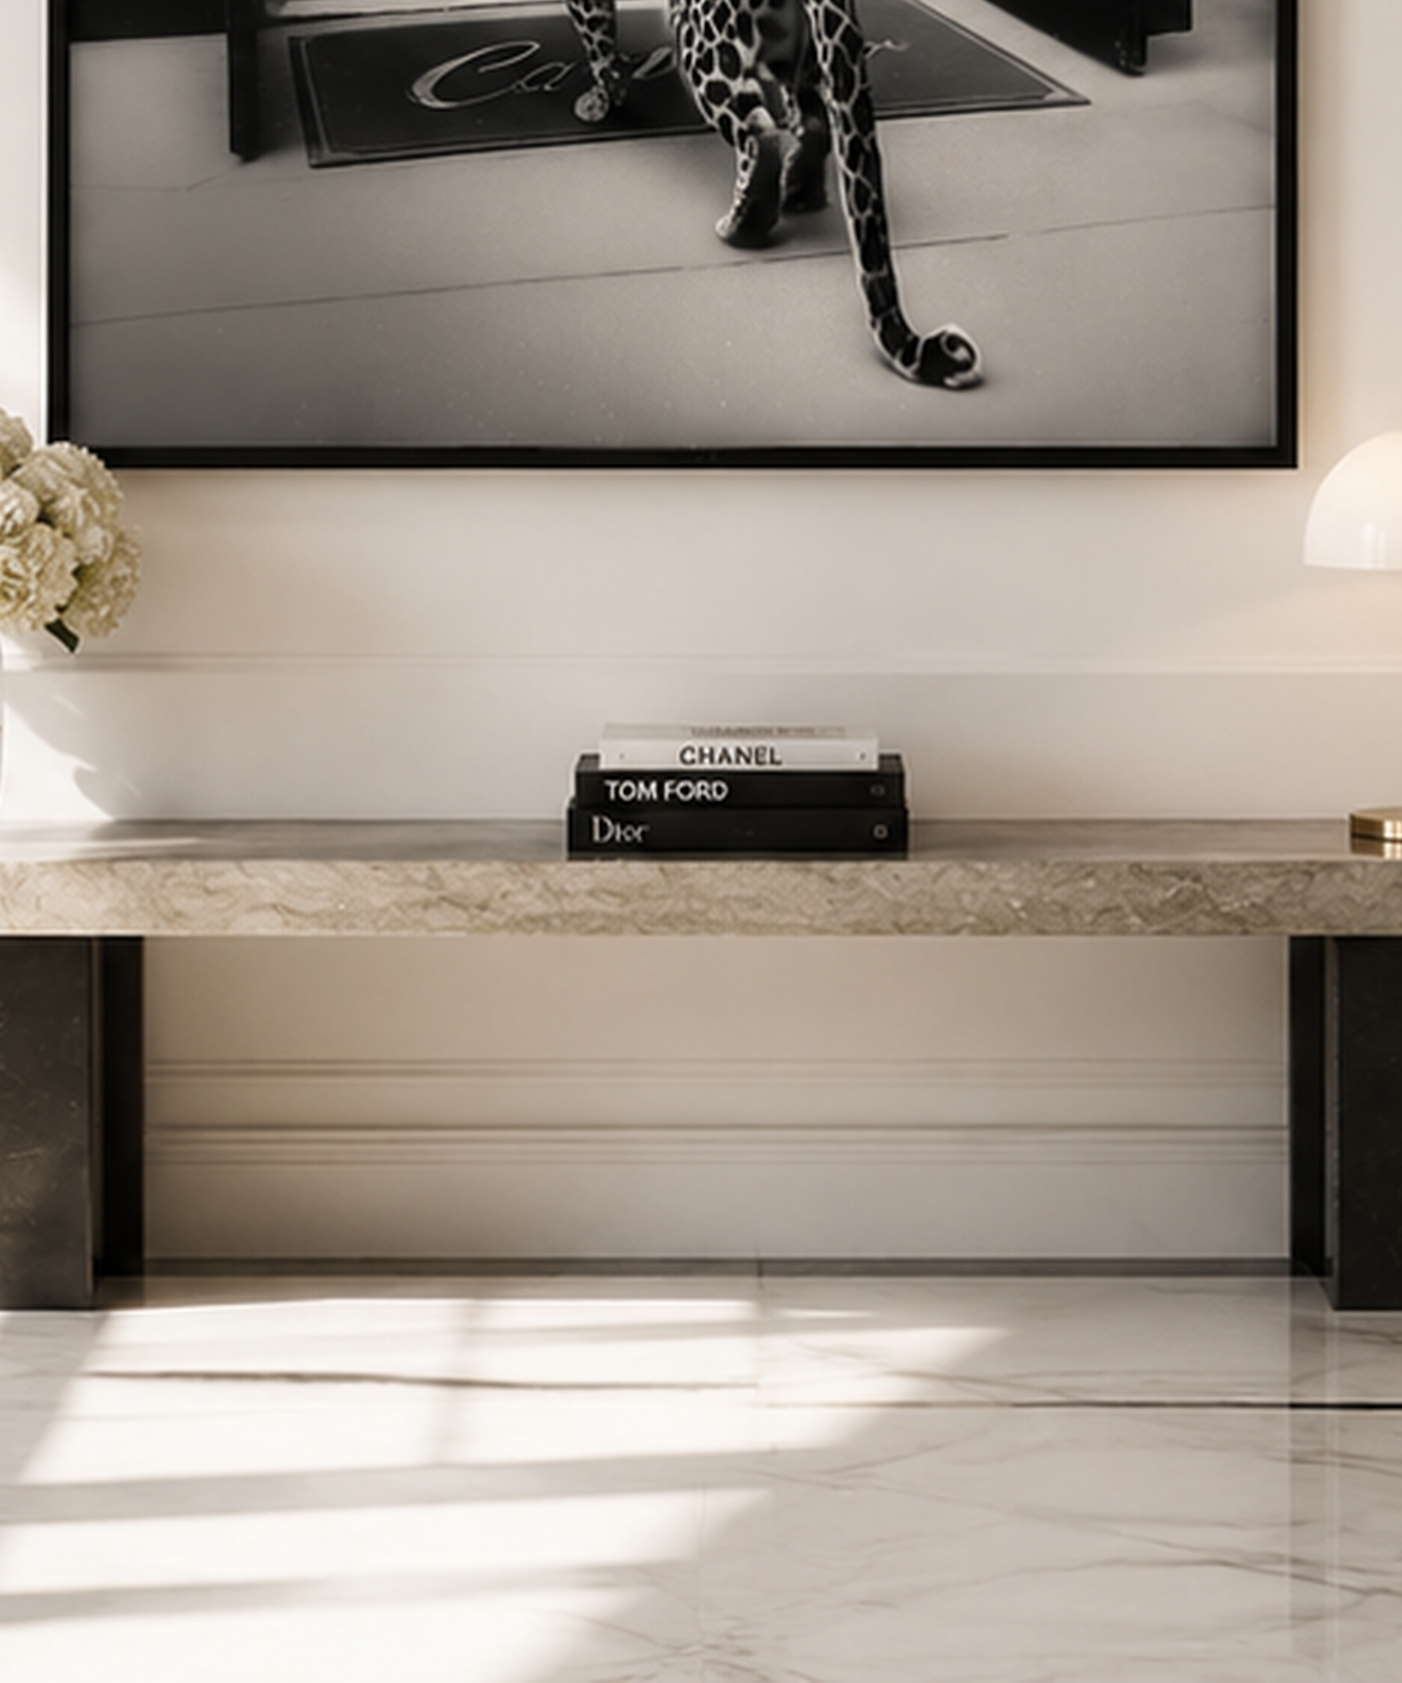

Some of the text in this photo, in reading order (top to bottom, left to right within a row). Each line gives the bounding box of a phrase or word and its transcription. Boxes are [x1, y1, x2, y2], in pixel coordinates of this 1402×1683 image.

[678, 744, 784, 766] CHANEL
[604, 779, 730, 802] TOM FORD
[591, 815, 650, 844] Dior
